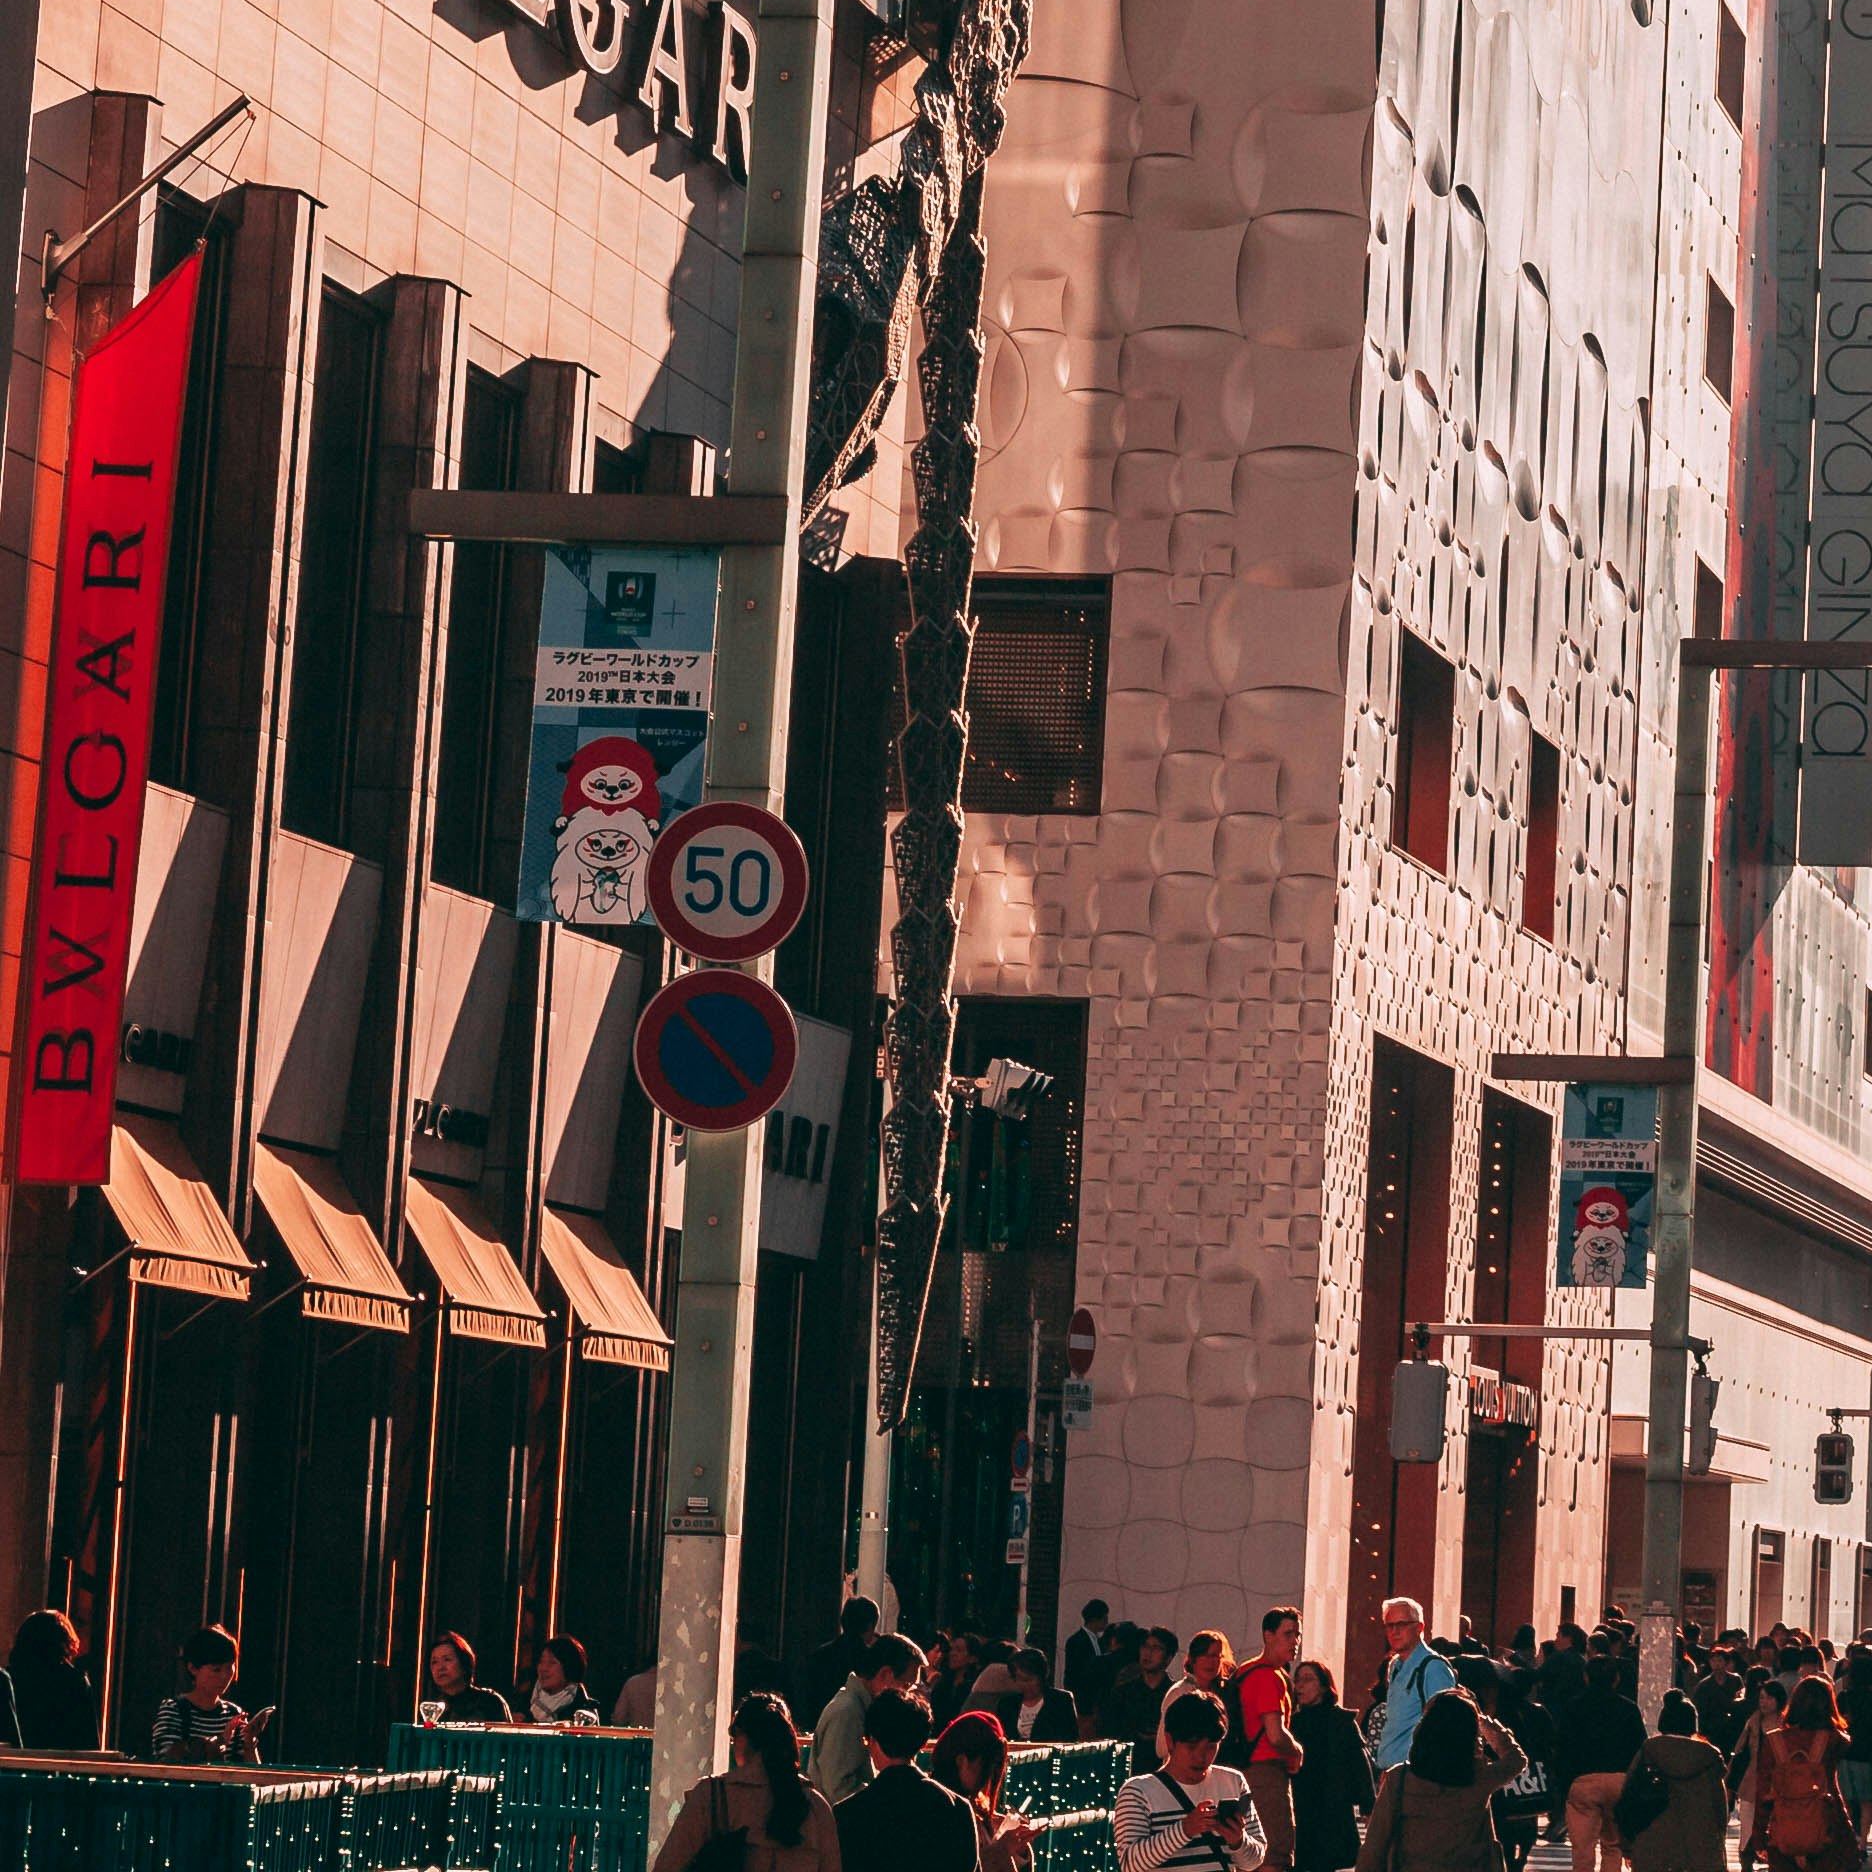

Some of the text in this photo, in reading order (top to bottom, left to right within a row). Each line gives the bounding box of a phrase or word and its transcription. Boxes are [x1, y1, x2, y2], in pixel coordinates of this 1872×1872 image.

[551, 651, 700, 668] ラグビーワールドカップ
[576, 669, 676, 686] 2019™日本大会
[32, 456, 155, 1097] BVLGARI
[685, 846, 770, 916] 50
[1473, 1375, 1539, 1430] LOUIS VUITTON
